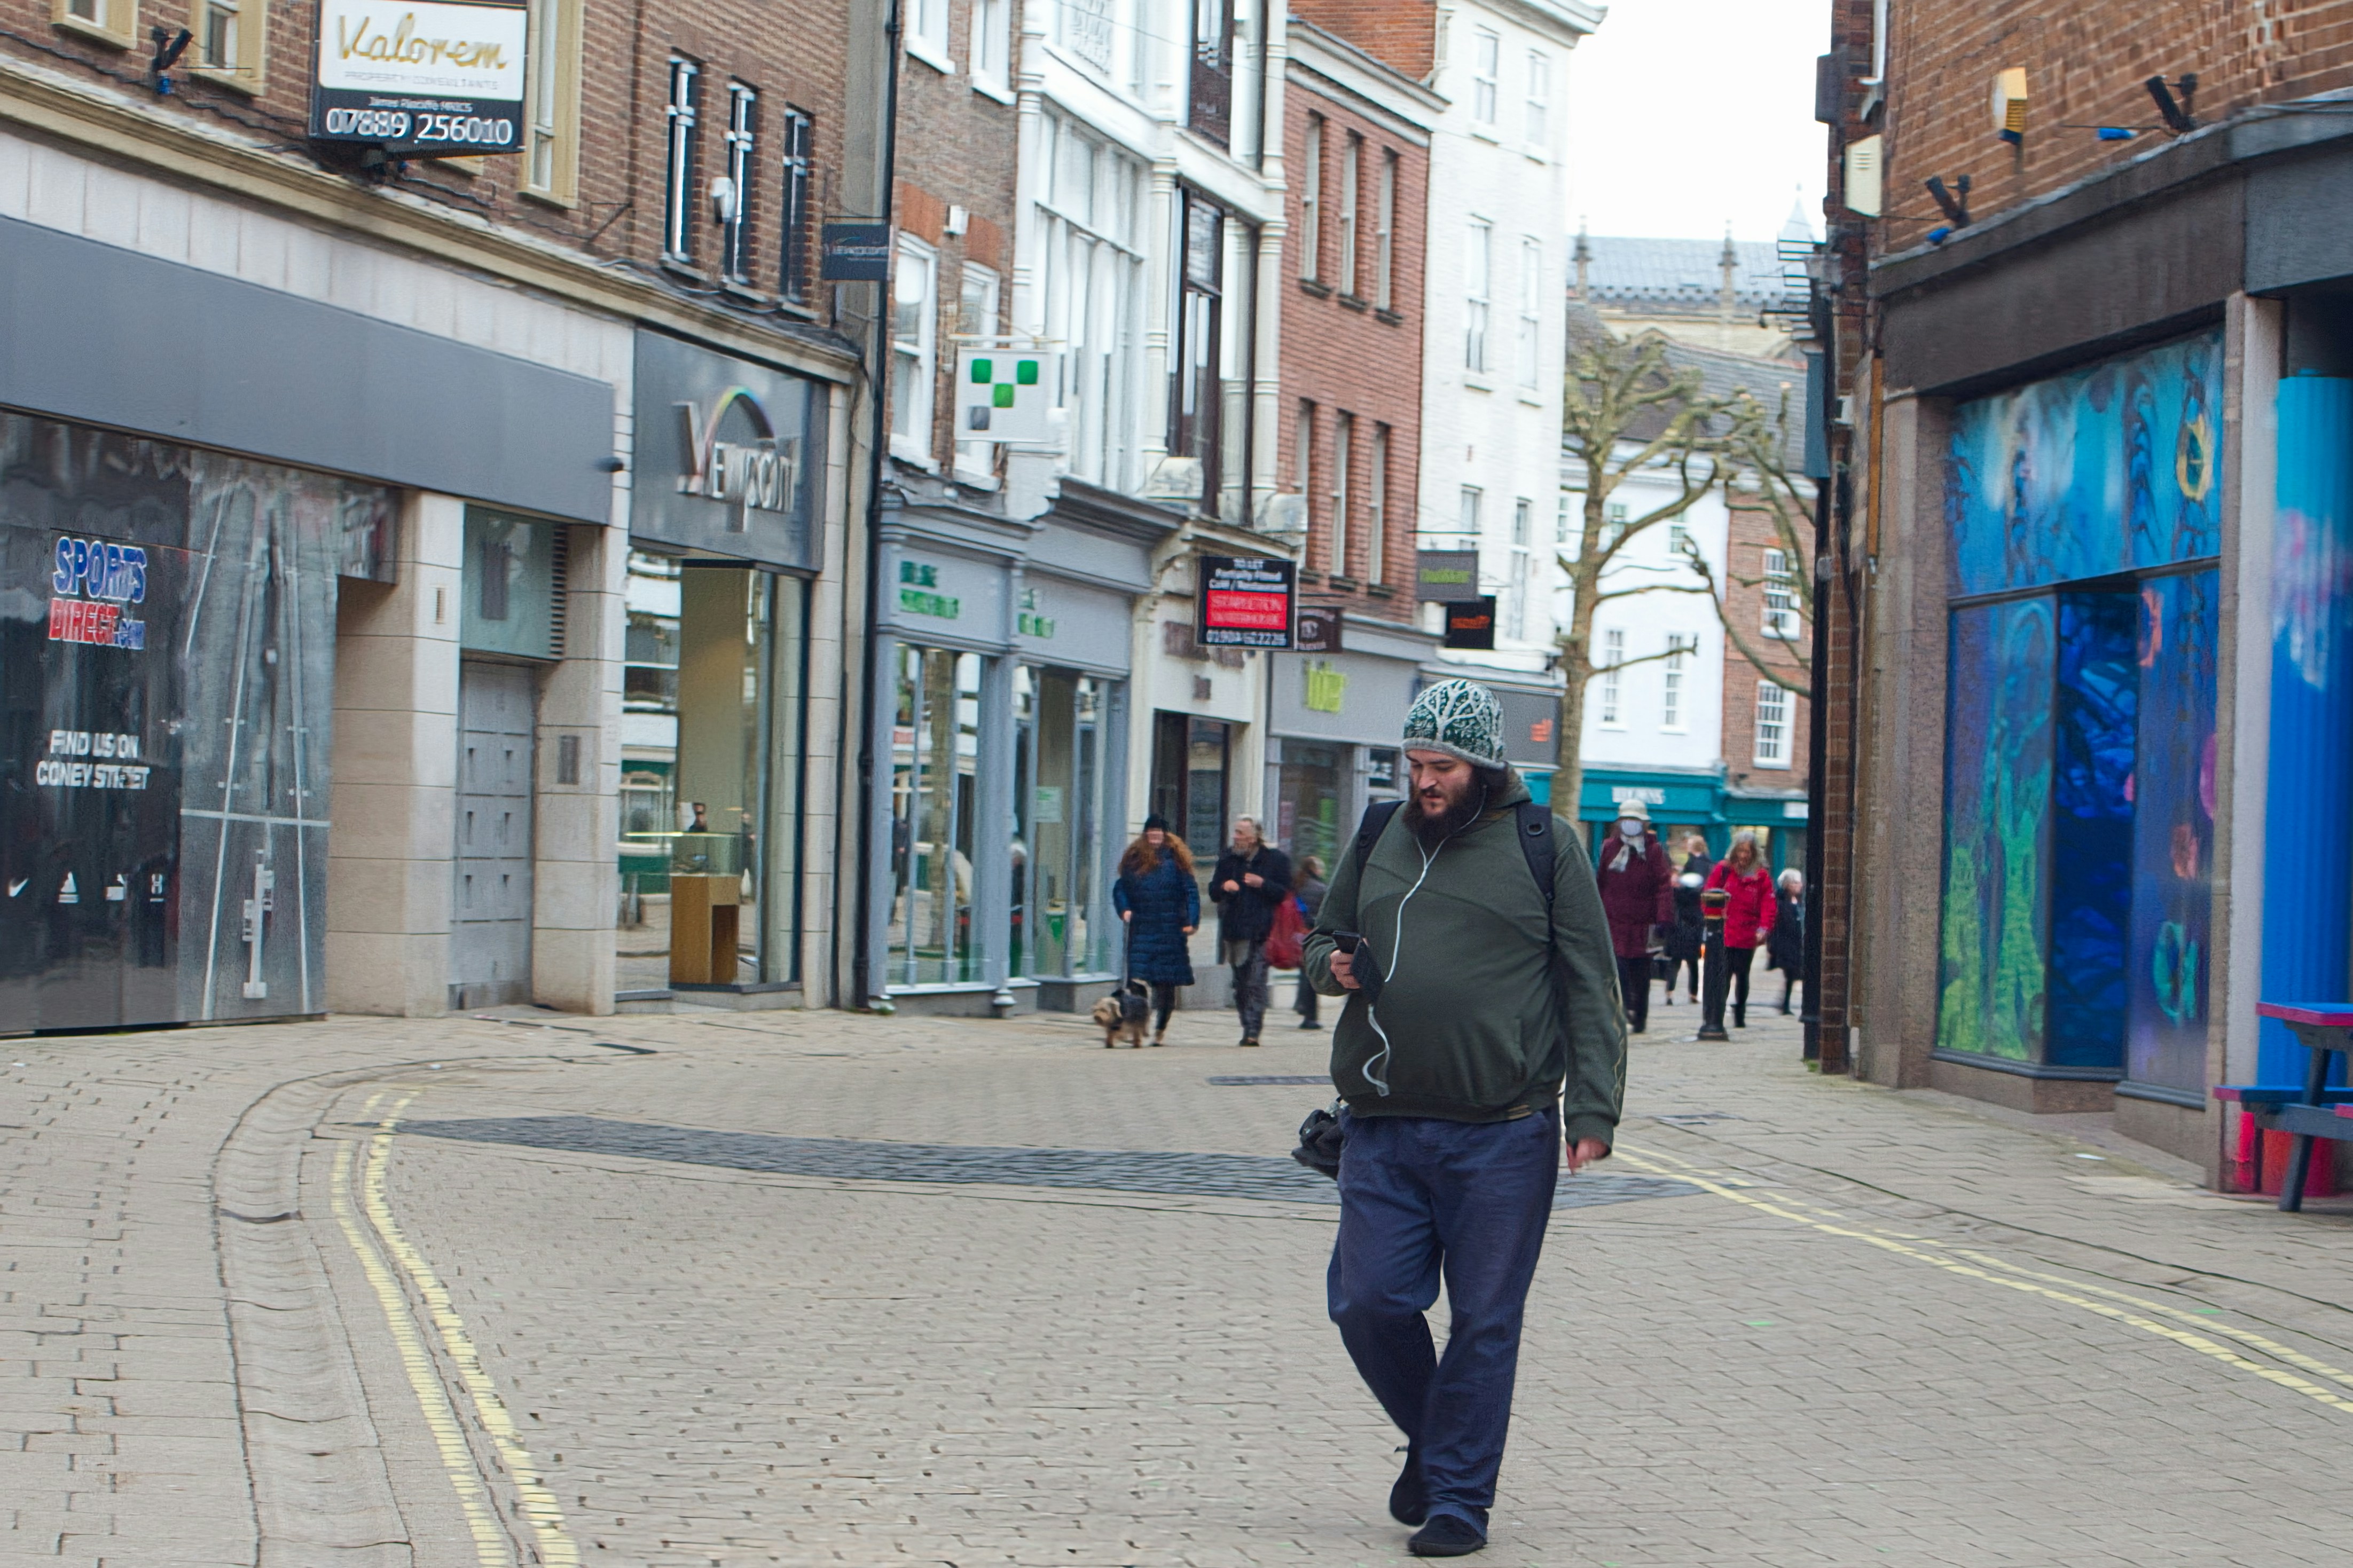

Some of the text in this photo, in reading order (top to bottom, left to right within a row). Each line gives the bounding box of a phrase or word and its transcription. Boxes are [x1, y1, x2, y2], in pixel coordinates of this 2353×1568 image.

[339, 12, 509, 69] Valorem
[326, 108, 513, 145] 07889 256010
[53, 536, 147, 604] SPORTS
[50, 729, 139, 759] FIND US ON
[36, 760, 151, 790] CONEY STREET
